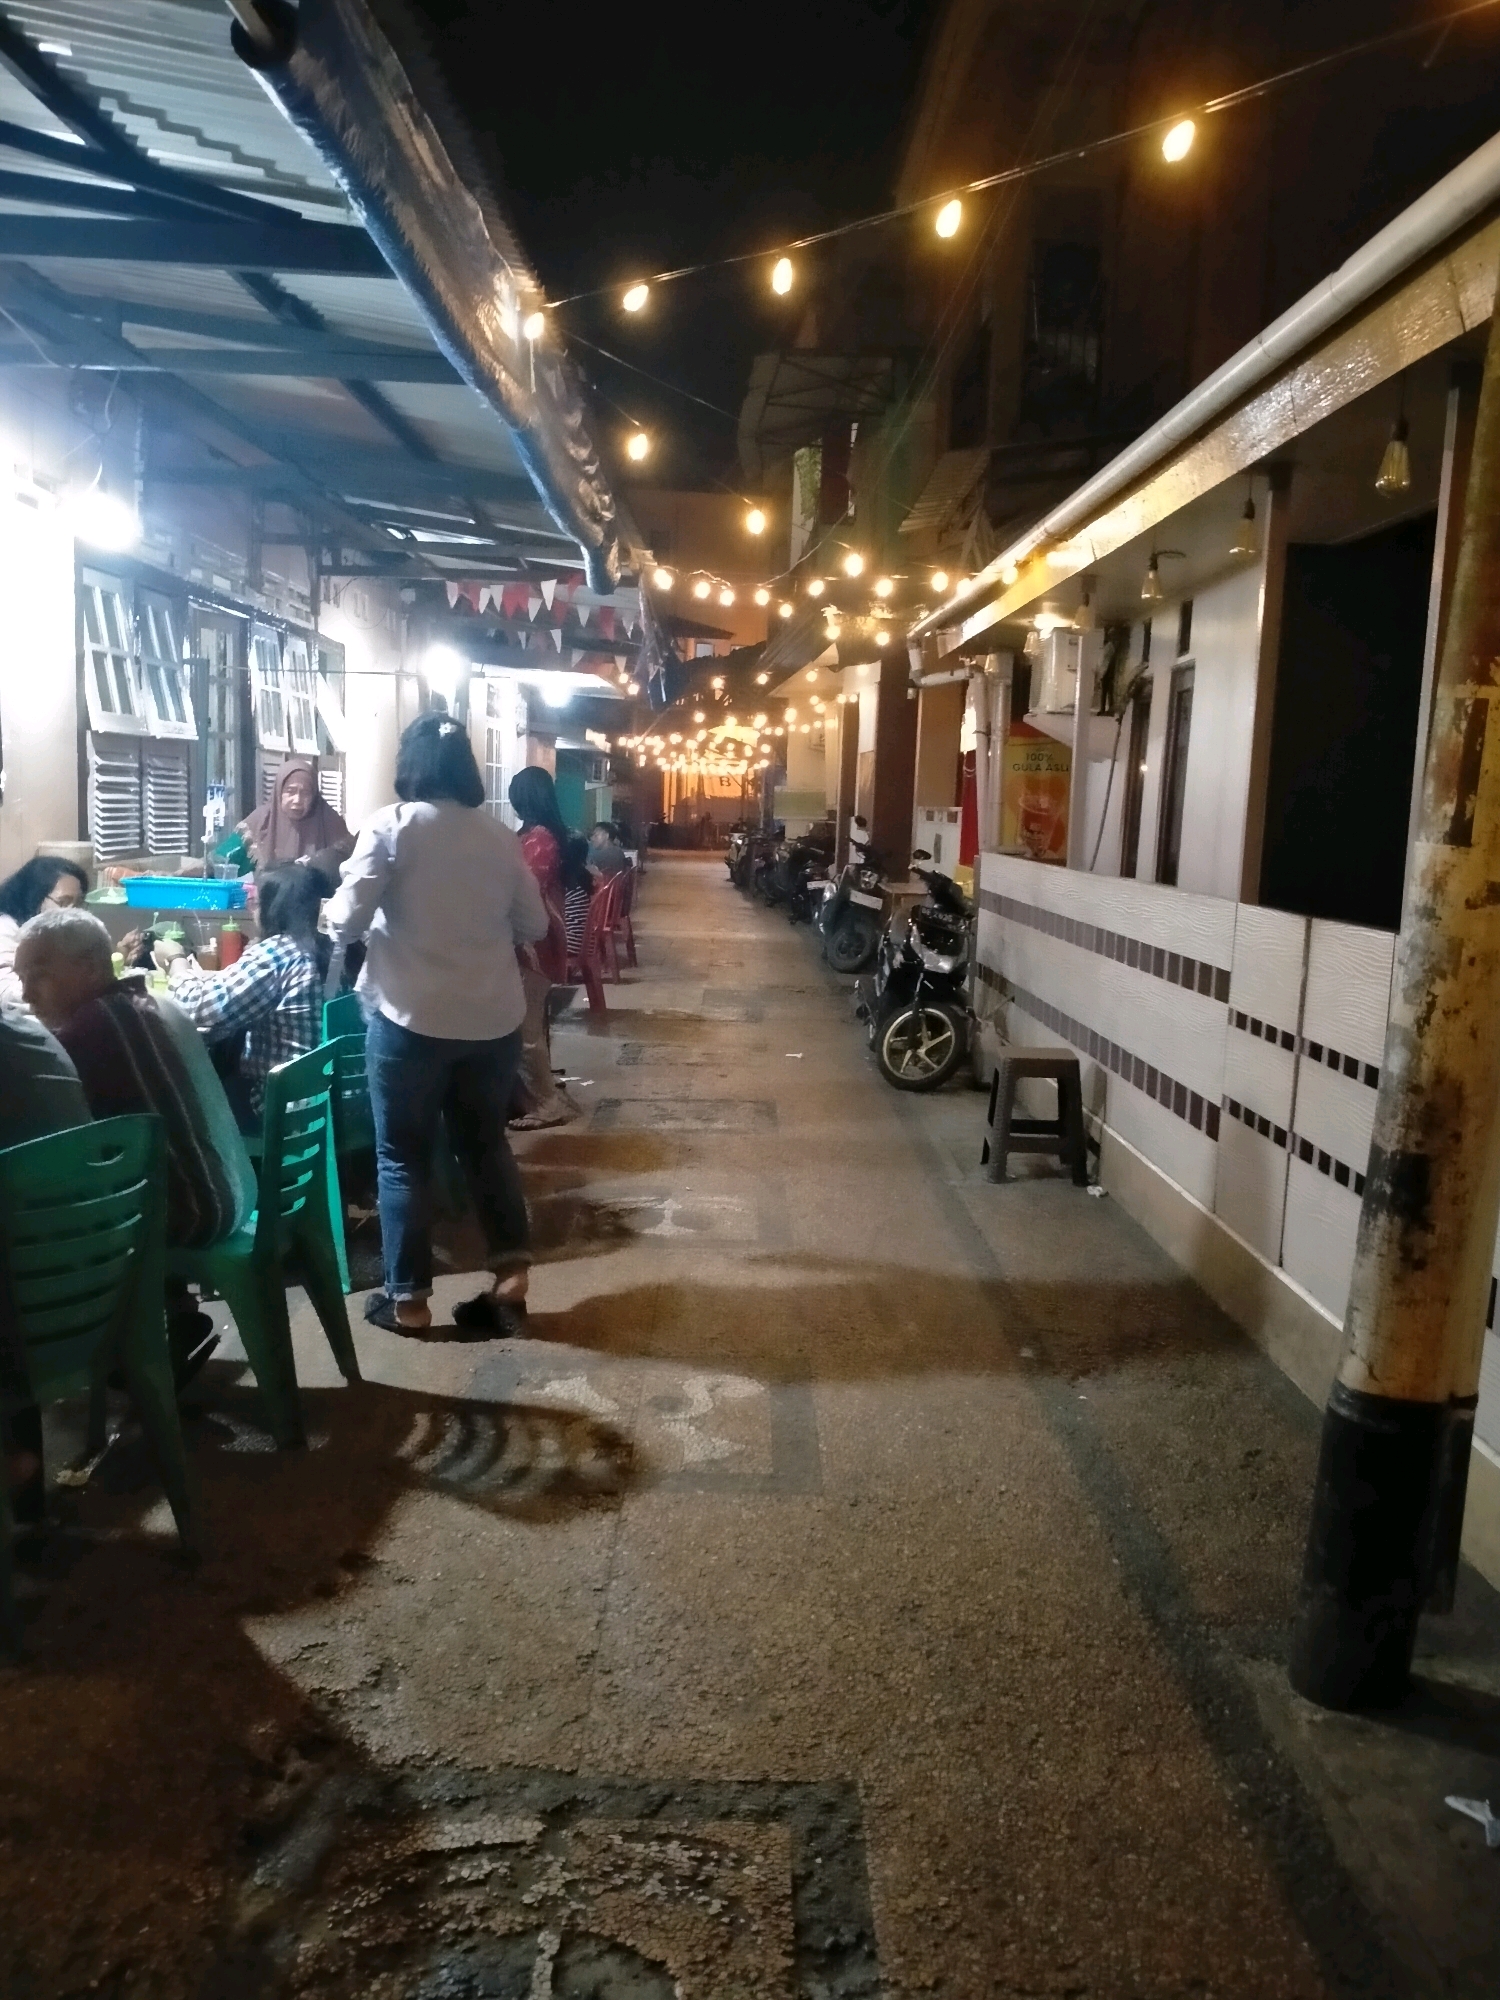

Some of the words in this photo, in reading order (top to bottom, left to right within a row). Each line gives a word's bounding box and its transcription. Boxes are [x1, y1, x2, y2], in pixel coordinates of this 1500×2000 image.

[1026, 752, 1054, 761] 100%
[1012, 763, 1042, 771] GULA
[1045, 763, 1069, 772] ASLI
